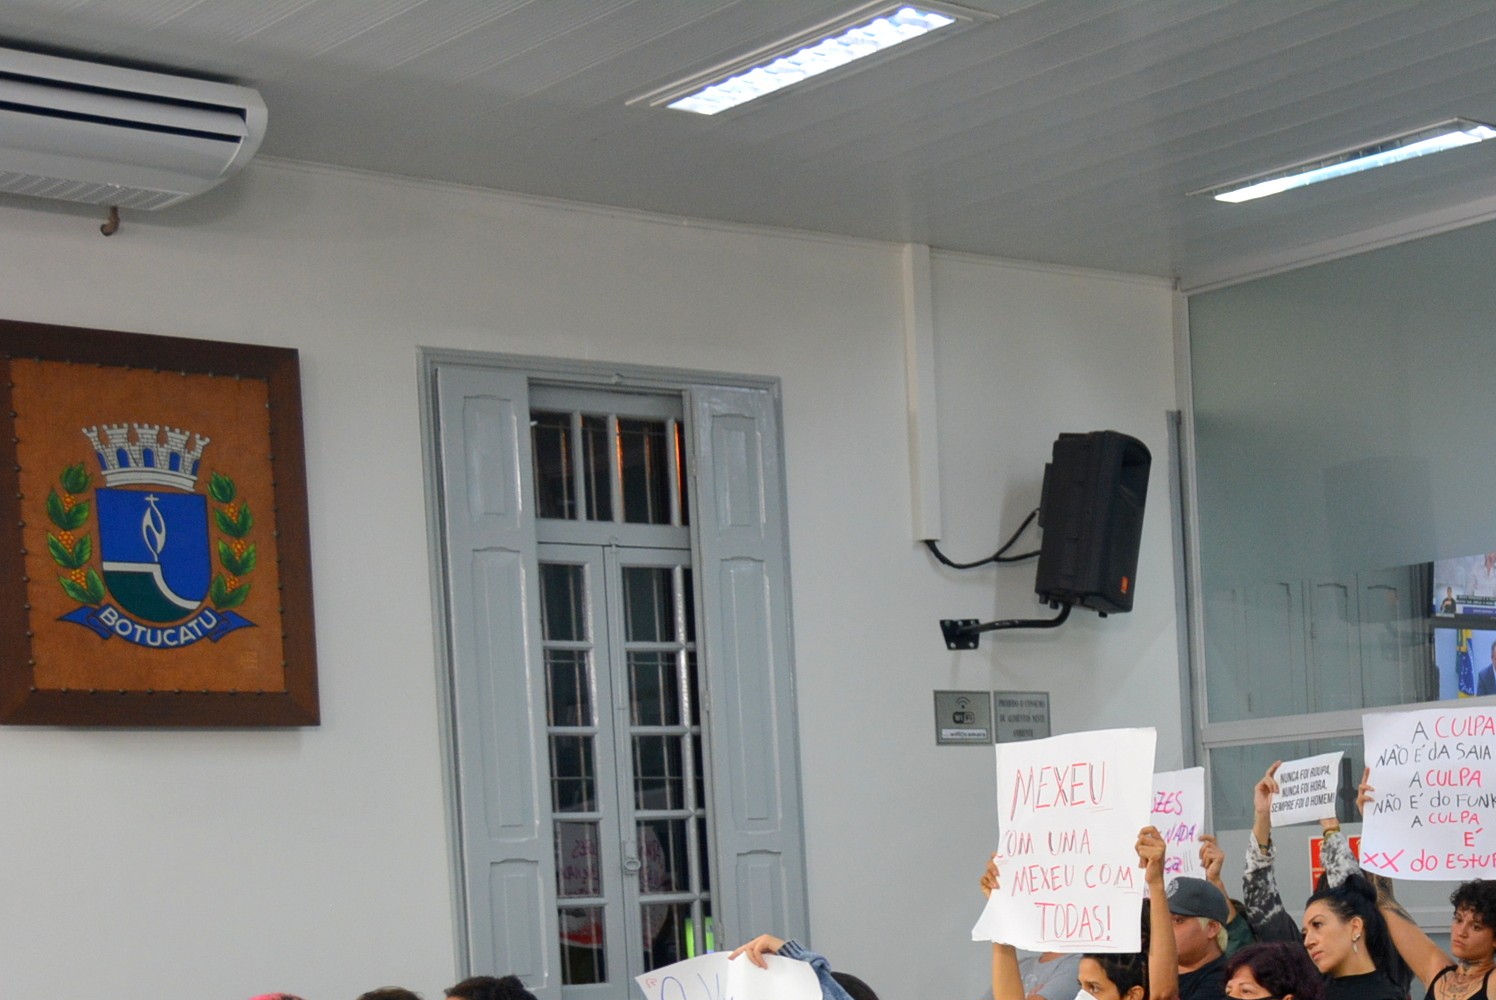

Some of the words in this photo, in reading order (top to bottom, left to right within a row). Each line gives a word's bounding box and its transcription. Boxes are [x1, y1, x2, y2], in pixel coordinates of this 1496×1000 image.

[100, 607, 218, 646] BOTUCATU
[1412, 721, 1429, 743] A
[1435, 715, 1496, 738] CULPA
[1376, 744, 1409, 768] NÃO
[1280, 770, 1299, 783] NUNCA
[1300, 768, 1309, 780] FOI
[1409, 771, 1422, 789] A
[1425, 767, 1483, 787] CULPA
[1010, 761, 1106, 821] MEXEU
[1282, 784, 1299, 797] NUNCA
[1300, 782, 1310, 794] FOI
[1271, 799, 1295, 813] SEMPRE
[1295, 798, 1305, 809] FOI
[1305, 796, 1310, 807] O
[1373, 793, 1402, 815] NÃO
[1411, 815, 1423, 828] A
[1428, 810, 1480, 825] CULPA
[1048, 828, 1091, 856] UMA
[1464, 828, 1483, 847] É
[1012, 864, 1074, 896] MEXEU
[1084, 863, 1133, 888] COM
[1034, 903, 1112, 941] TODAS!
